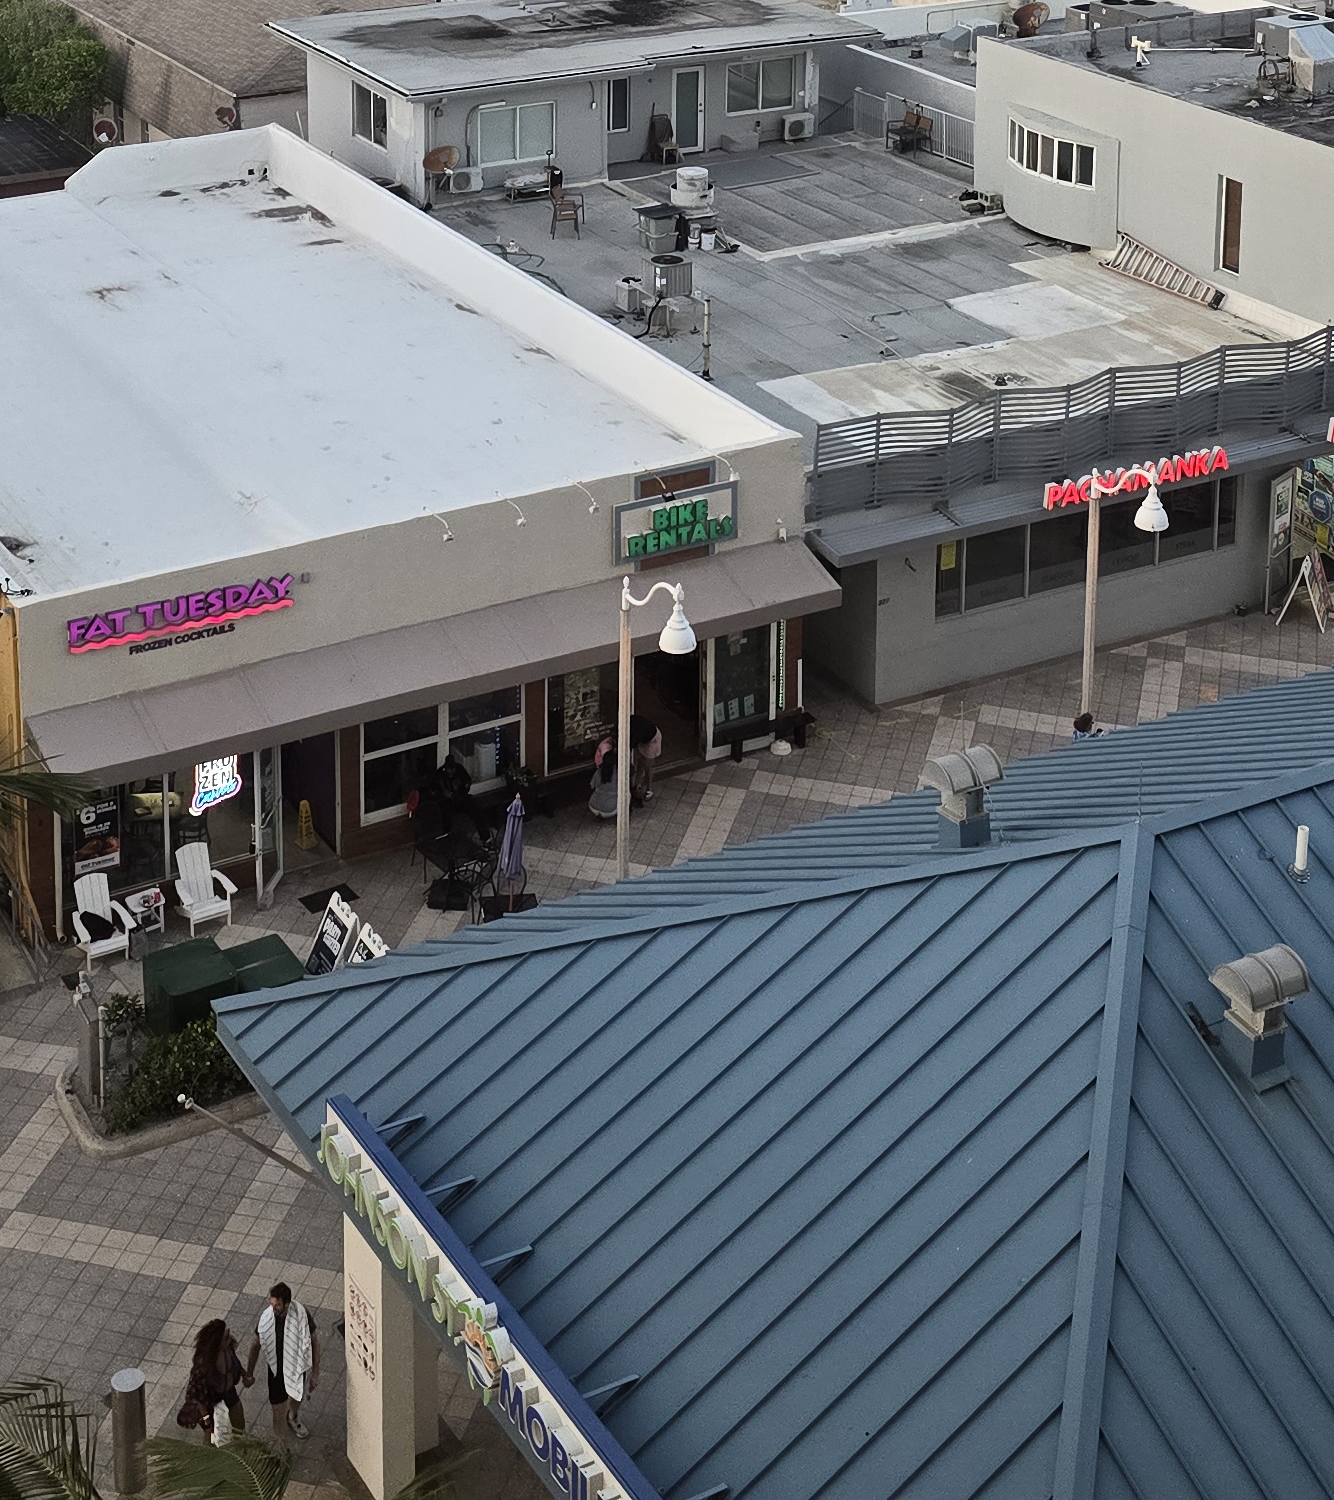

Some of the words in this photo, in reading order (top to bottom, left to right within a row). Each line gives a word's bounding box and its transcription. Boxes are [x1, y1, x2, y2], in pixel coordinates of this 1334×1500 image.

[652, 498, 709, 531] BIKE
[628, 516, 734, 557] RENTALS
[68, 610, 131, 643] FAT
[137, 573, 294, 630] TUESDAY
[129, 638, 172, 655] FROZEN
[174, 623, 236, 645] COCKTAILS
[200, 771, 233, 790] ZEN
[317, 1123, 433, 1302] JOHNSON
